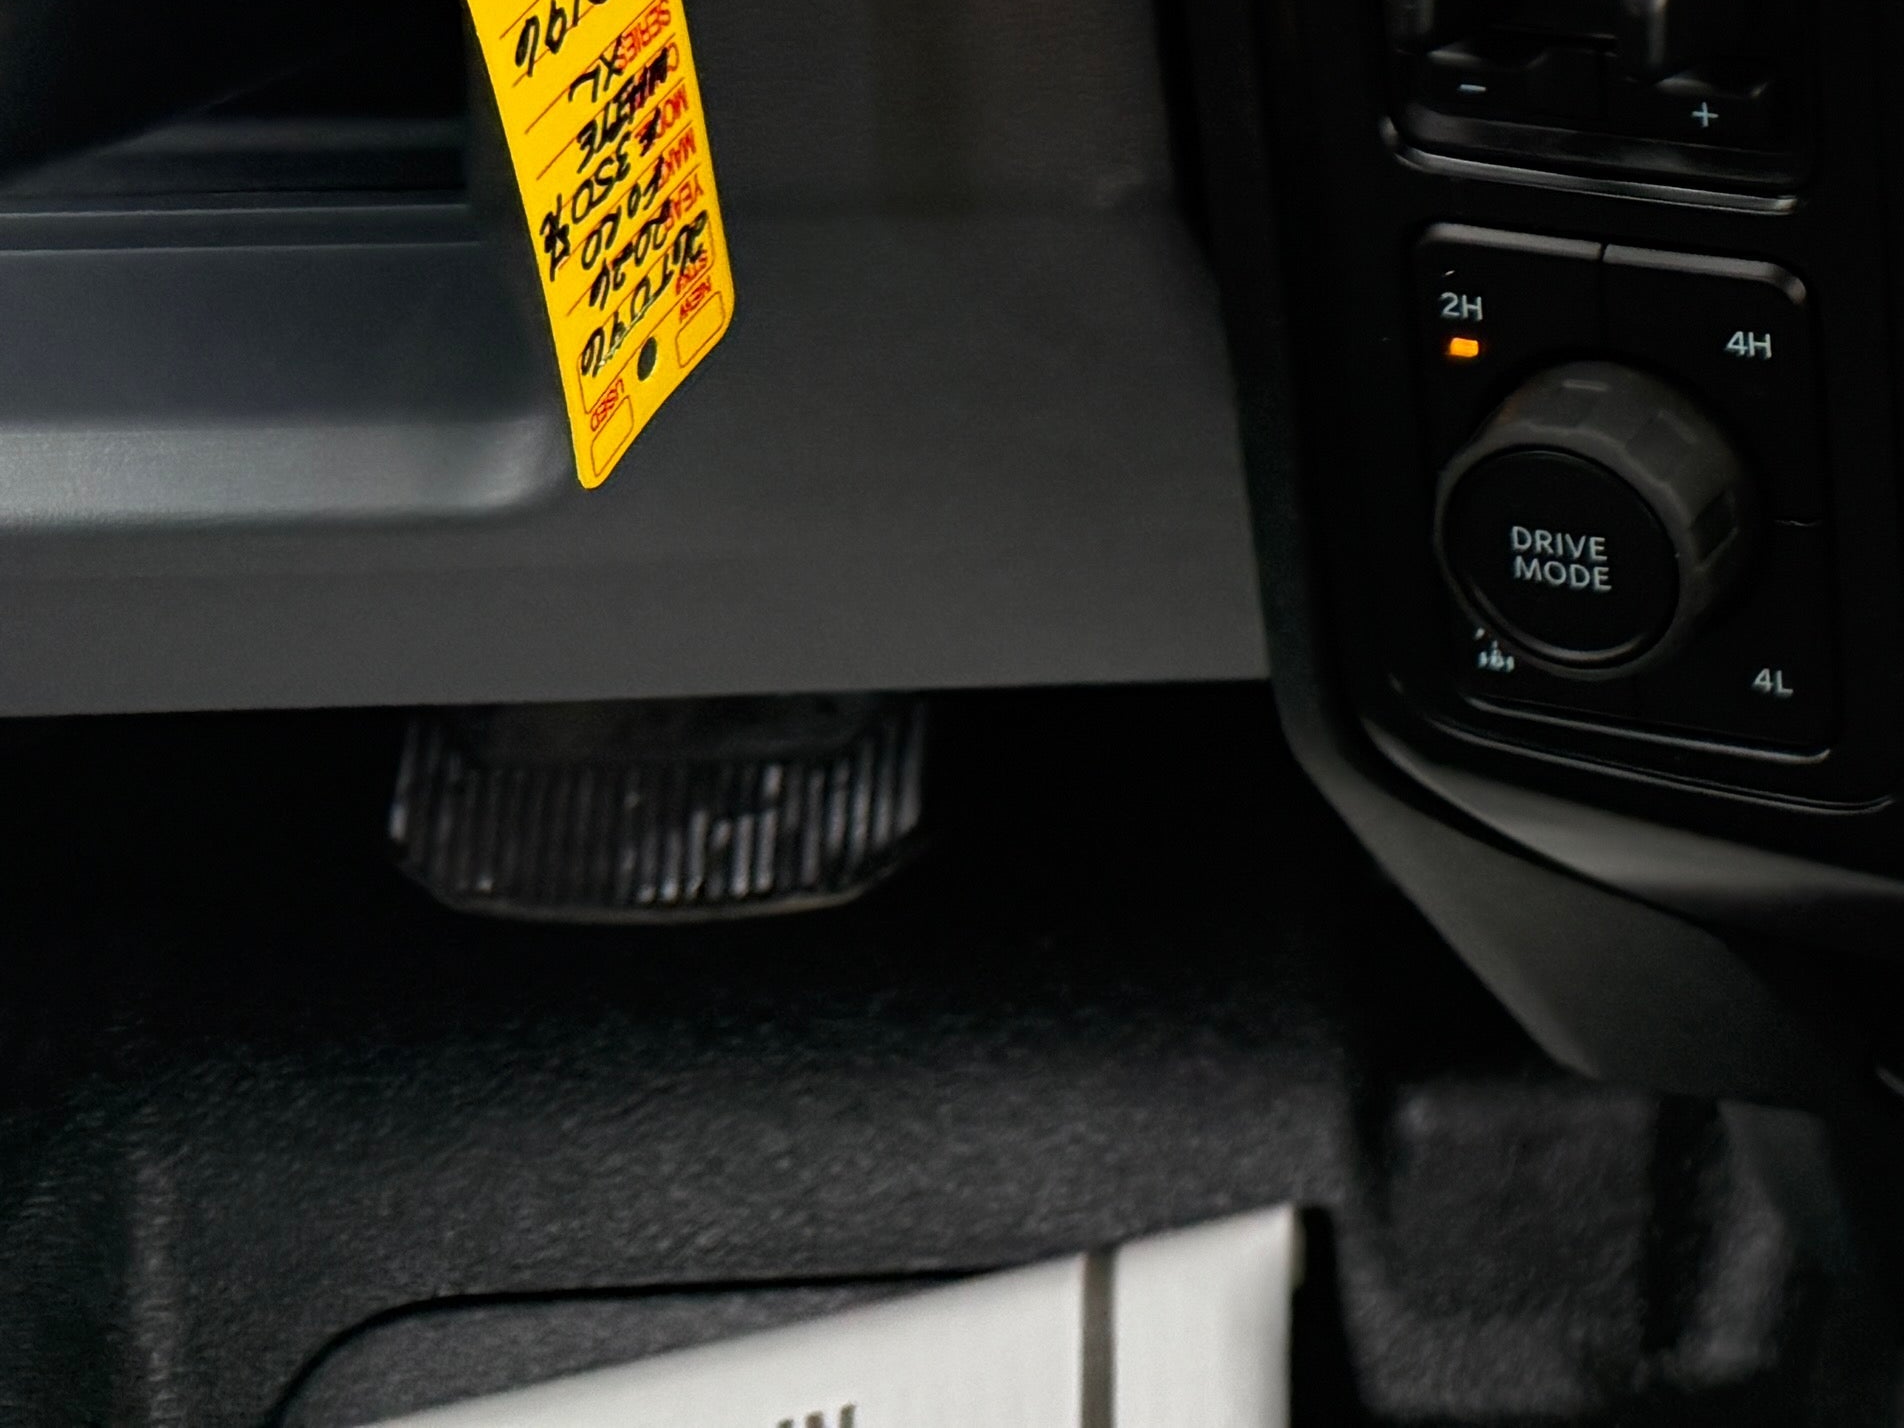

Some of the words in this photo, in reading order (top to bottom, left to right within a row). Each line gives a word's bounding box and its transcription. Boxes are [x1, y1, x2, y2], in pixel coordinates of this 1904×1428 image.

[581, 155, 664, 270] FORD
[589, 198, 672, 310] 2026
[678, 275, 712, 324] NEW
[1441, 292, 1482, 320] 2H
[1727, 331, 1772, 358] 4H
[590, 378, 625, 433] USED
[1511, 526, 1608, 561] DRIVE
[1514, 556, 1612, 591] MODE
[1753, 669, 1793, 695] 4L
